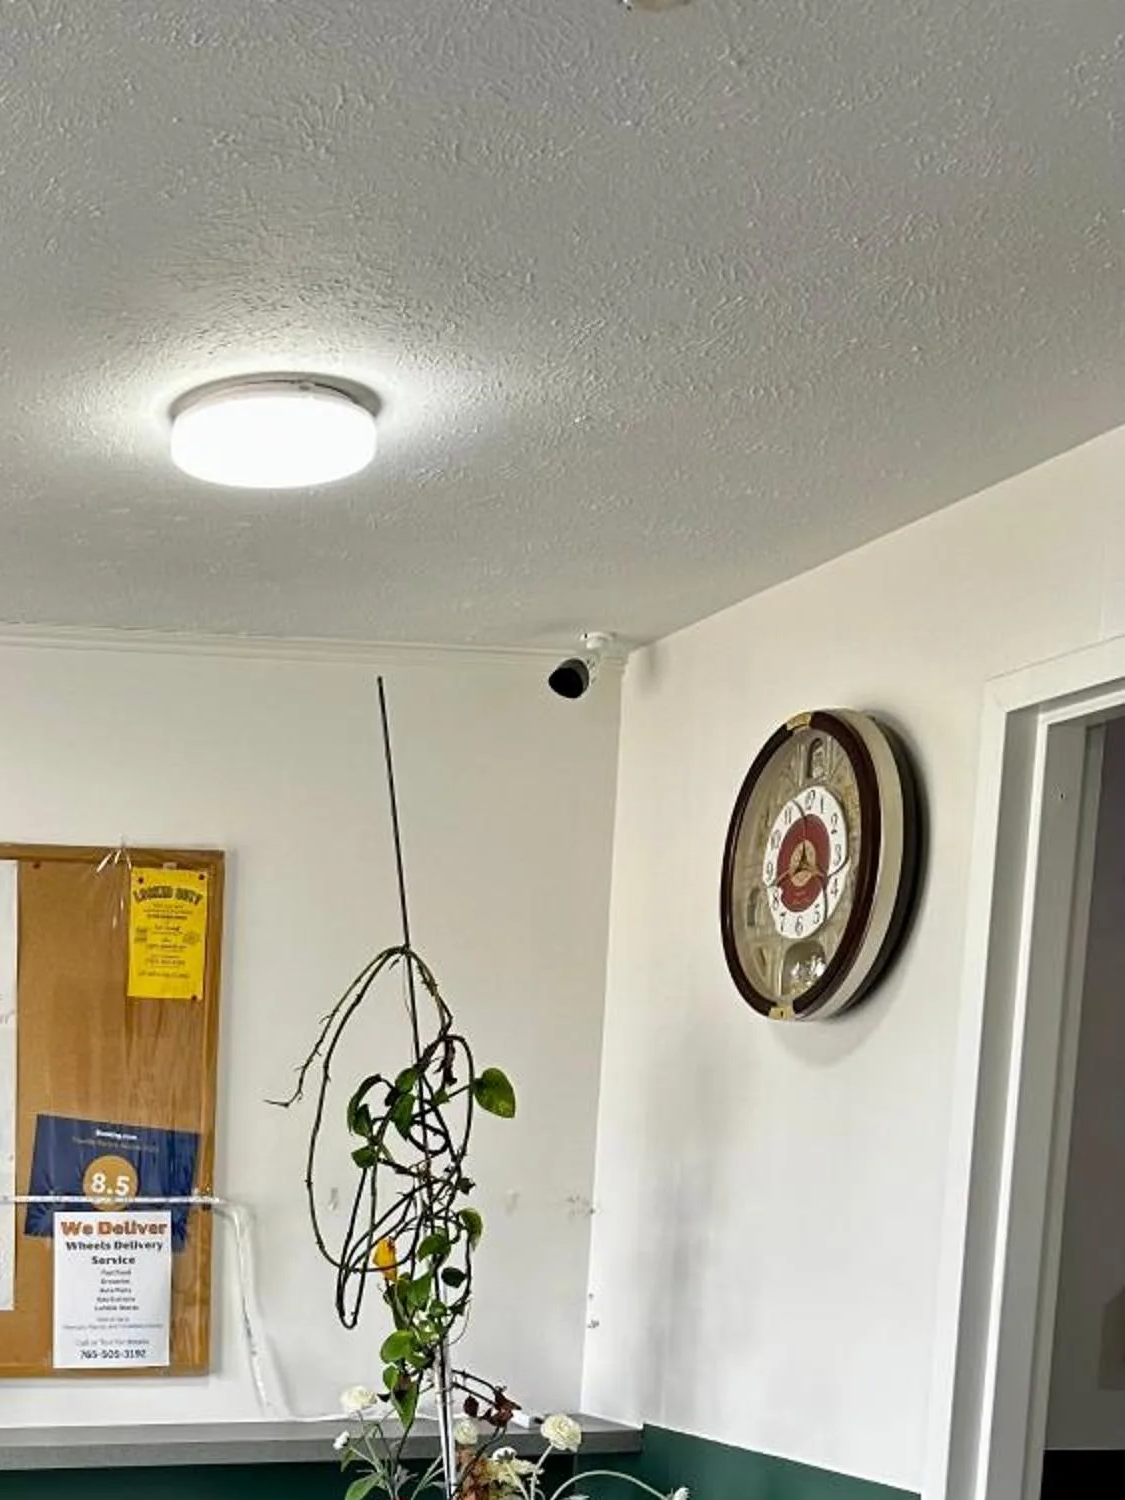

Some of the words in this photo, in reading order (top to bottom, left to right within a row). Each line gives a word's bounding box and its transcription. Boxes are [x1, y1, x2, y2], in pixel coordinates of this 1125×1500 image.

[830, 812, 839, 834] 2
[832, 843, 843, 866] 3
[766, 861, 775, 885] 9
[830, 877, 839, 896] 4
[779, 911, 787, 933] 7
[813, 903, 822, 925] 5
[794, 915, 804, 937] 6
[90, 1172, 131, 1196] 8.5
[60, 1221, 93, 1235] We
[98, 1220, 168, 1235] Deliver
[65, 1241, 111, 1250] Wheels
[114, 1240, 164, 1252] Delivery
[91, 1255, 136, 1265] Service
